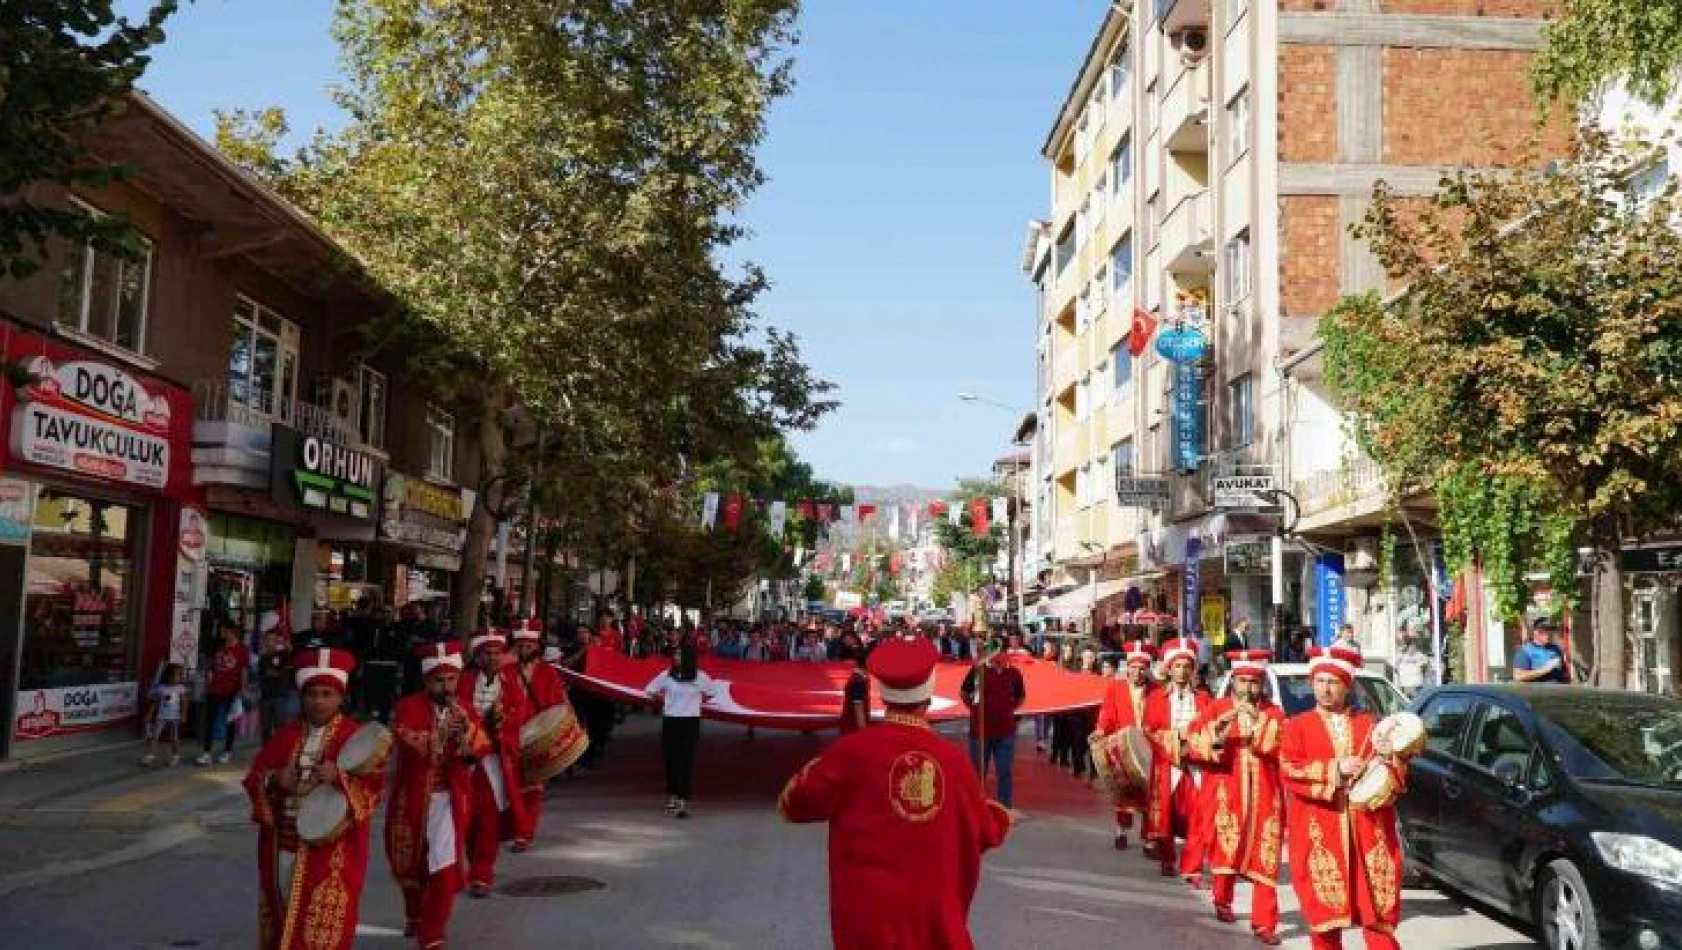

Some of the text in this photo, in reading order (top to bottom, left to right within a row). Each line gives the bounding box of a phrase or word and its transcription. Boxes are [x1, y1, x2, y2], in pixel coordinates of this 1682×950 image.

[76, 367, 136, 417] DOĞA
[304, 437, 373, 486] ORHUN
[1216, 478, 1270, 489] AVUKAT
